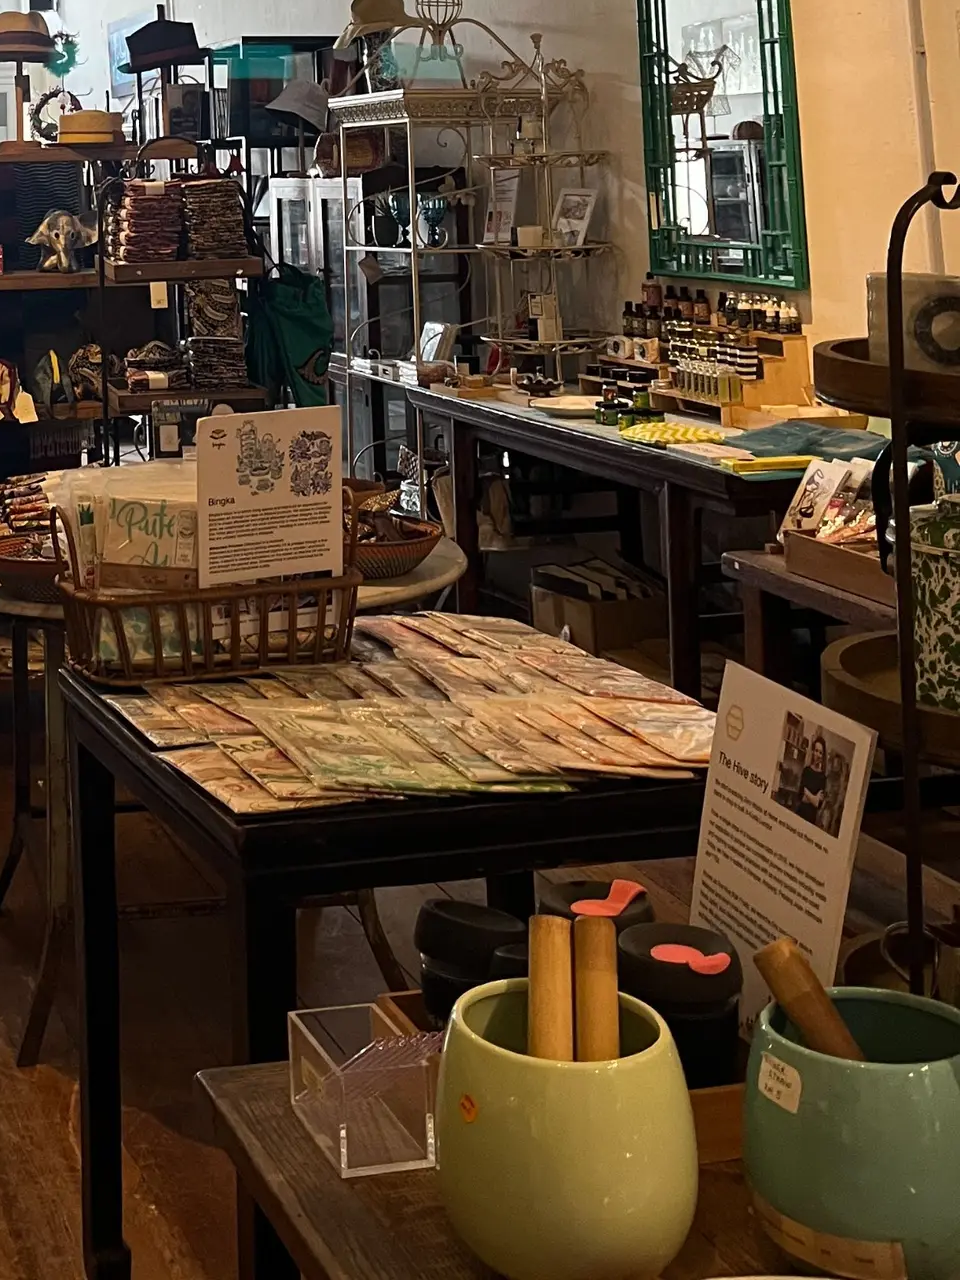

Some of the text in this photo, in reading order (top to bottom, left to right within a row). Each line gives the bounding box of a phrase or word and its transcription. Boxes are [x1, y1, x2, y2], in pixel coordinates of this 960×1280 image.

[208, 497, 236, 507] Bingka
[719, 750, 770, 794] The Hive story
